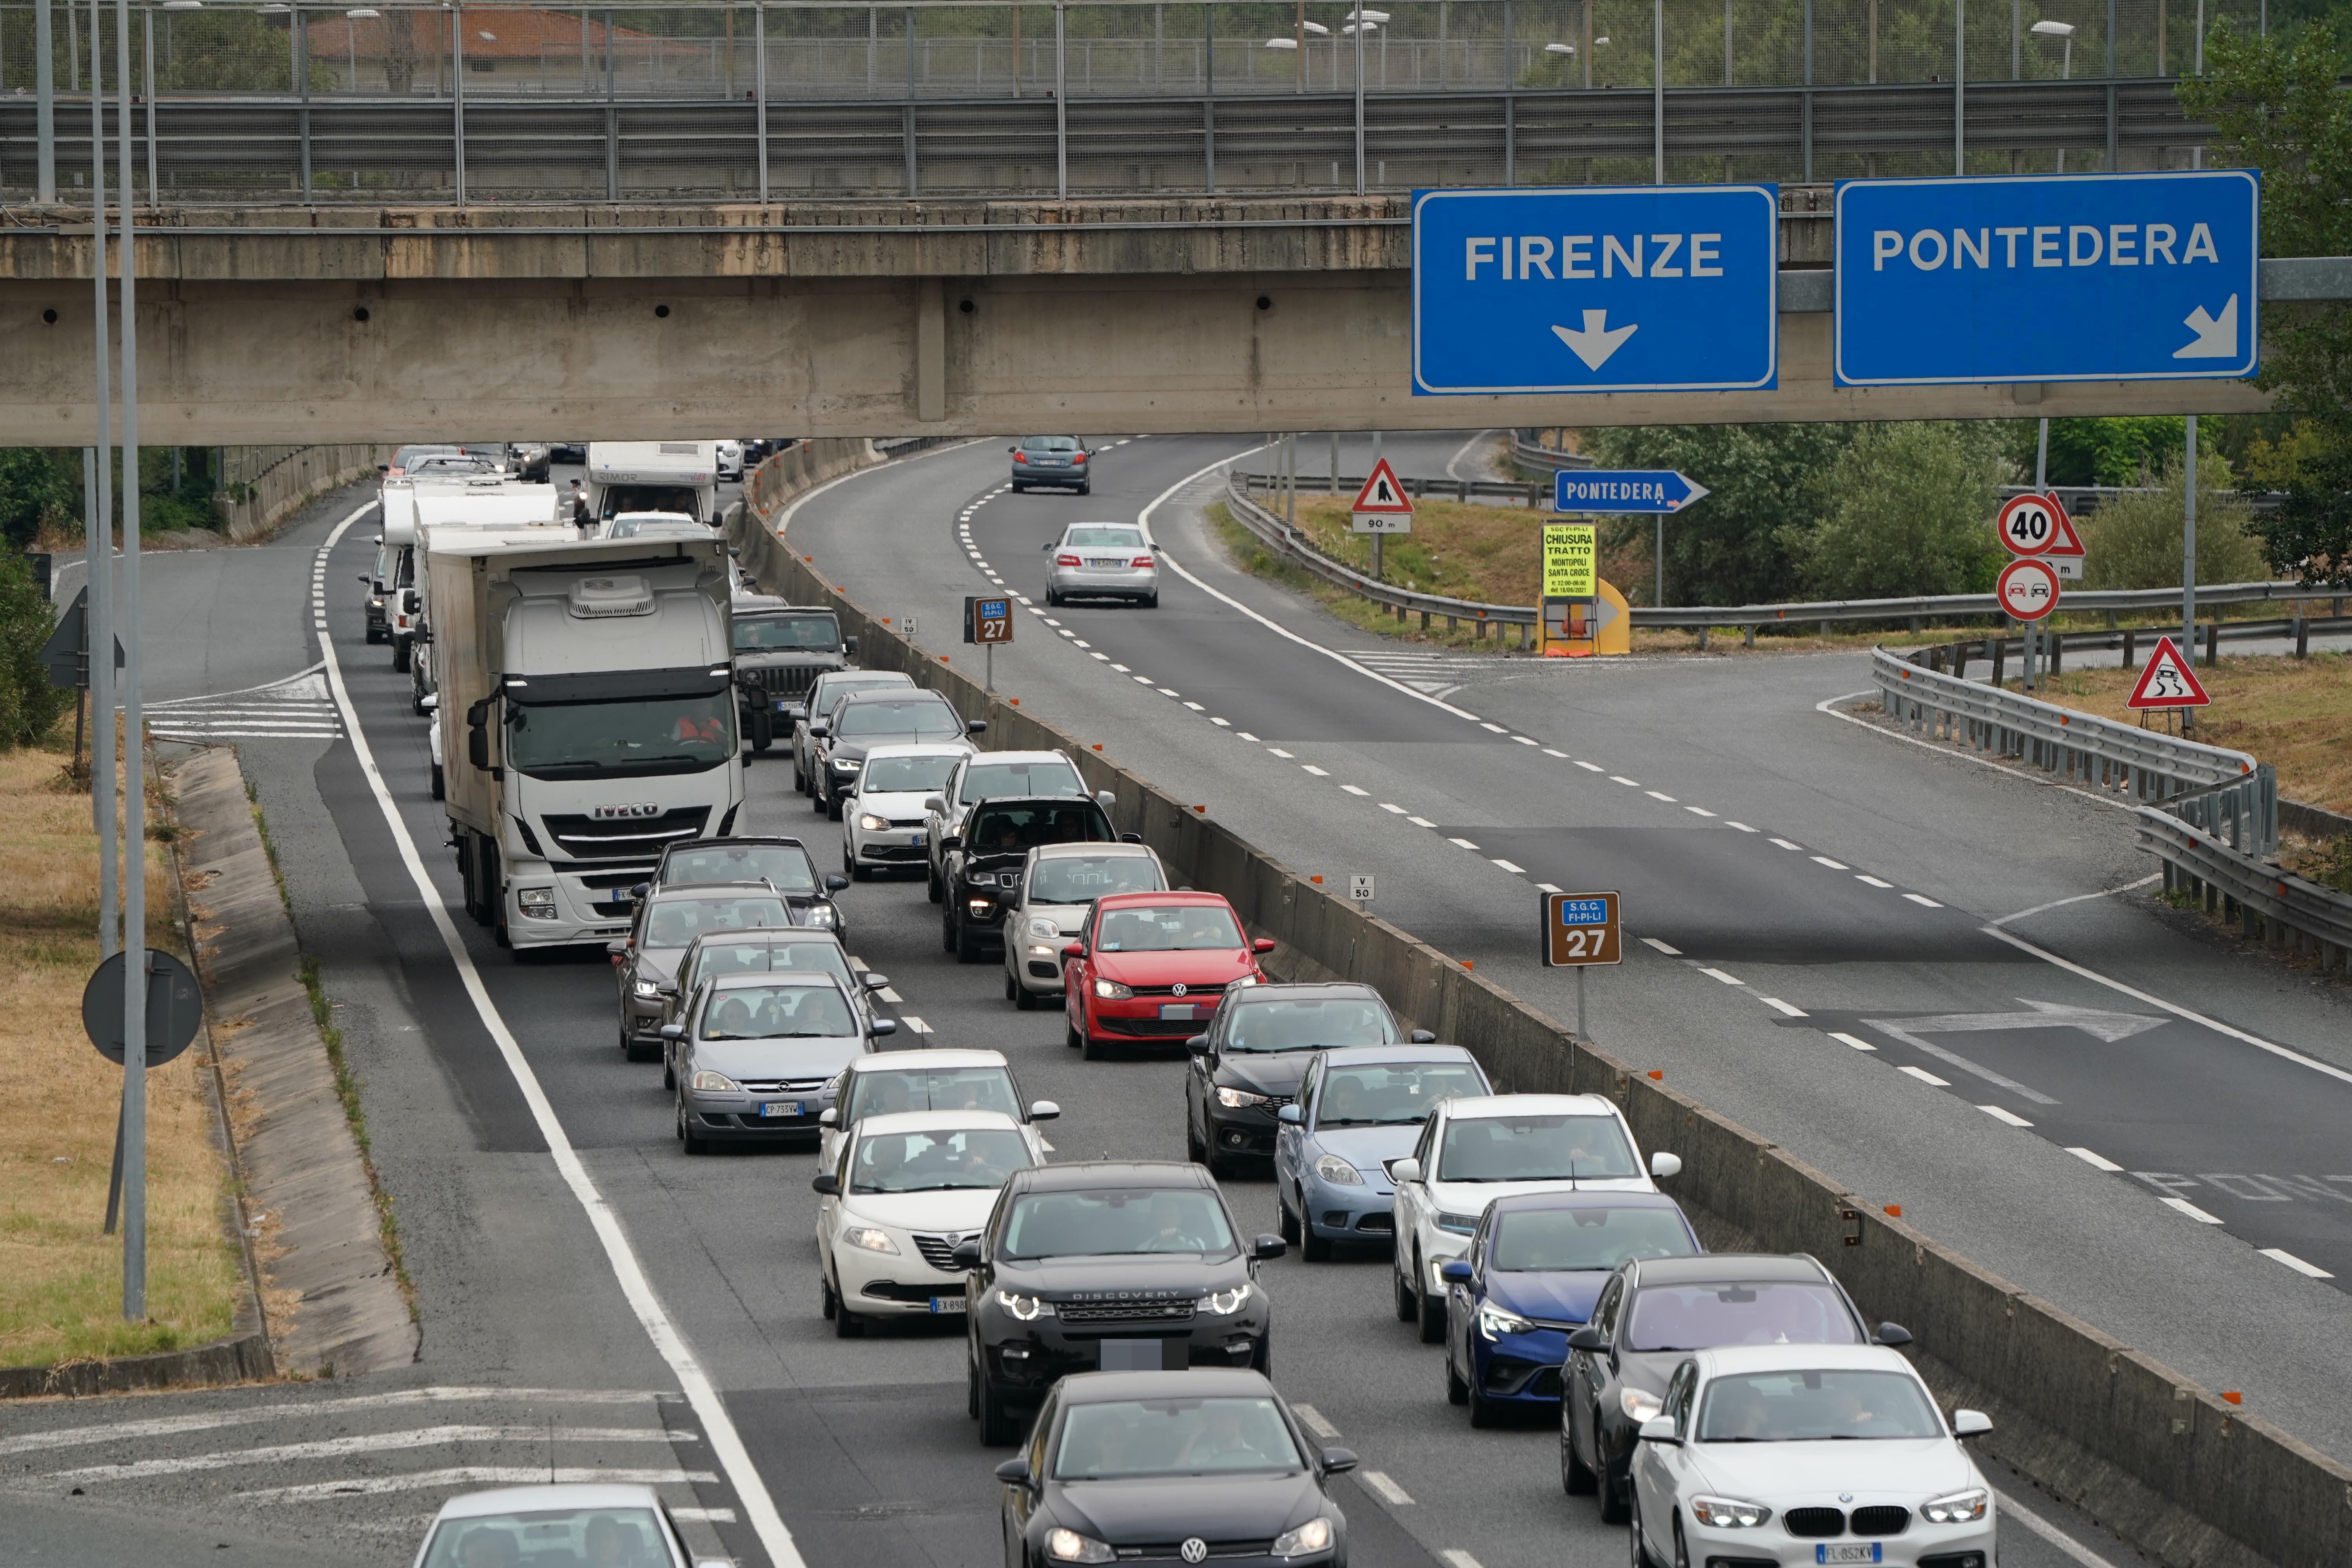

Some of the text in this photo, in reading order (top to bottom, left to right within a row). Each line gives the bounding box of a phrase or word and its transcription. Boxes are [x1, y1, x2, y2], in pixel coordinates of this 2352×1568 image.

[1874, 223, 2219, 271] PONTEDERA
[1466, 233, 1723, 280] FIRENZE
[1567, 482, 1664, 500] PONTEDERA
[2011, 511, 2047, 539] 40
[1546, 535, 1592, 544] CHIUSURA
[984, 620, 1005, 638] 27
[595, 802, 658, 817] IVECO
[1570, 902, 1599, 911] S.G.C.
[1569, 912, 1601, 922] FI-PI-LI
[1566, 929, 1605, 957] 27
[1073, 1291, 1178, 1300] DISCOVERY
